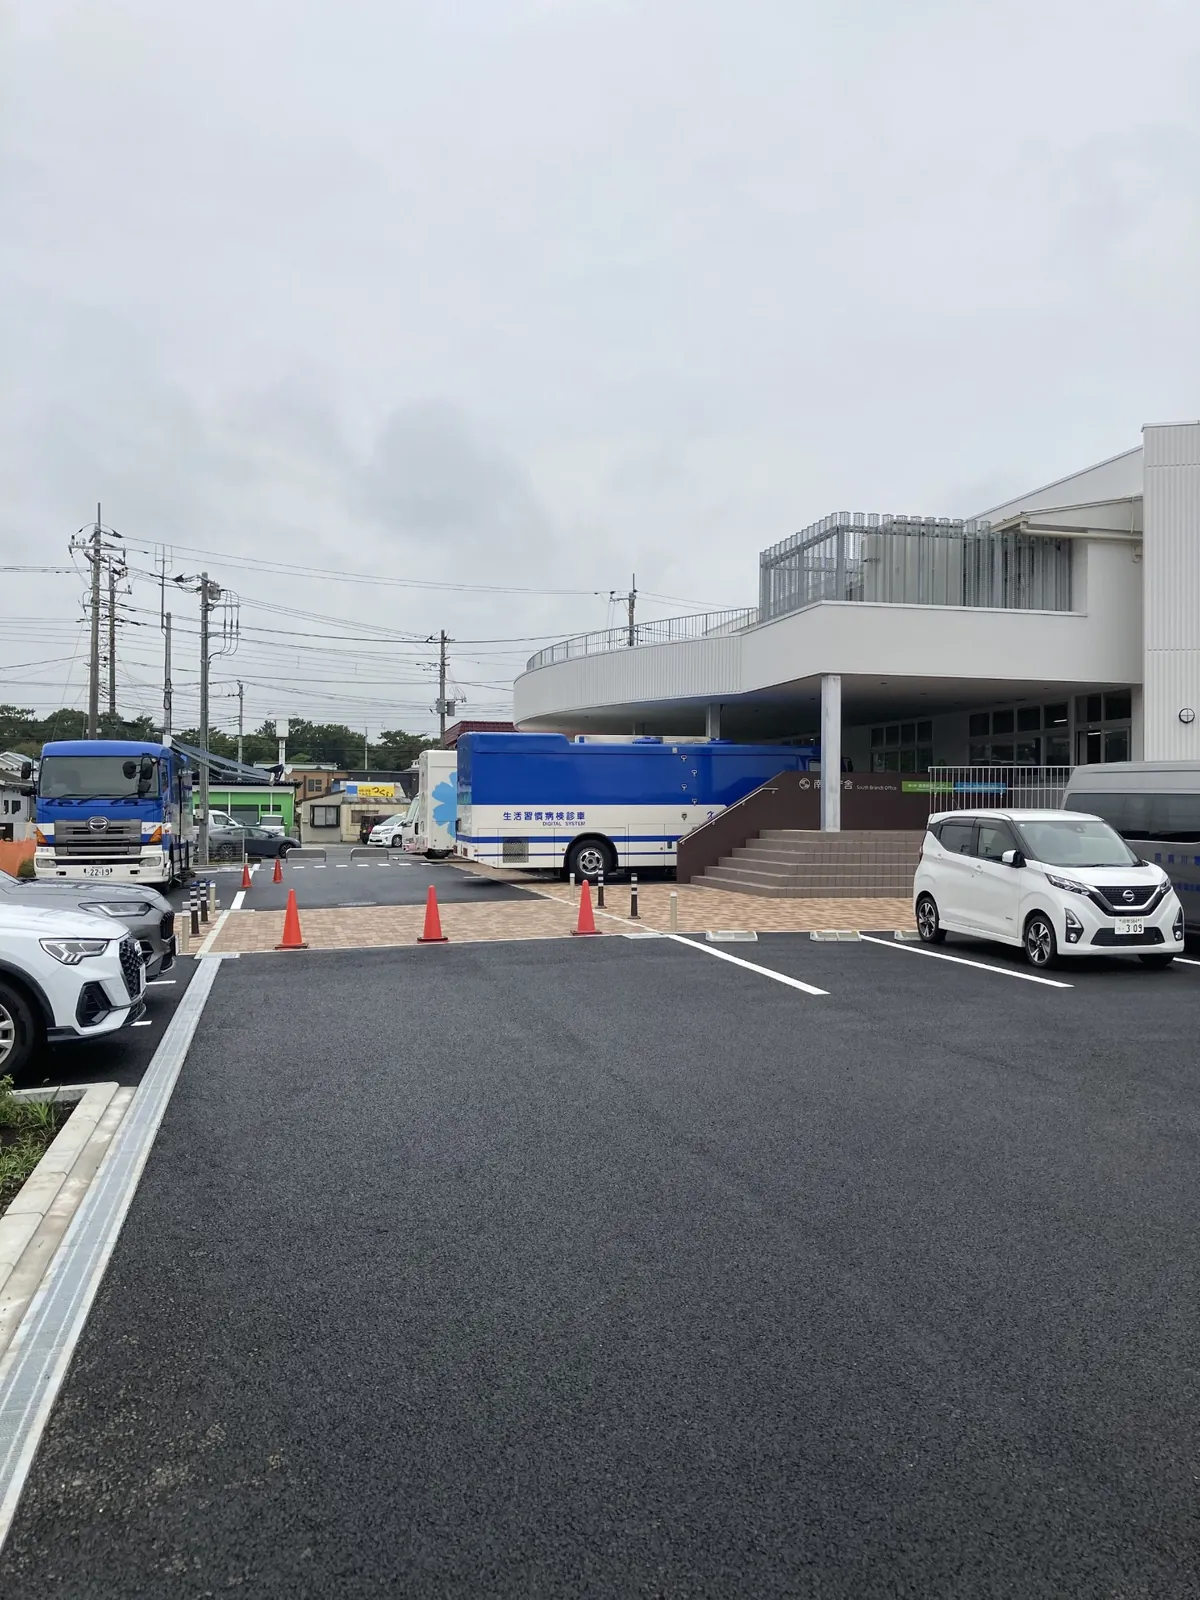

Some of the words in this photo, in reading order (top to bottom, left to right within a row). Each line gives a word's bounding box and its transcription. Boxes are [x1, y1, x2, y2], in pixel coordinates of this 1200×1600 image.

[503, 811, 585, 821] 生活習慣病検診車
